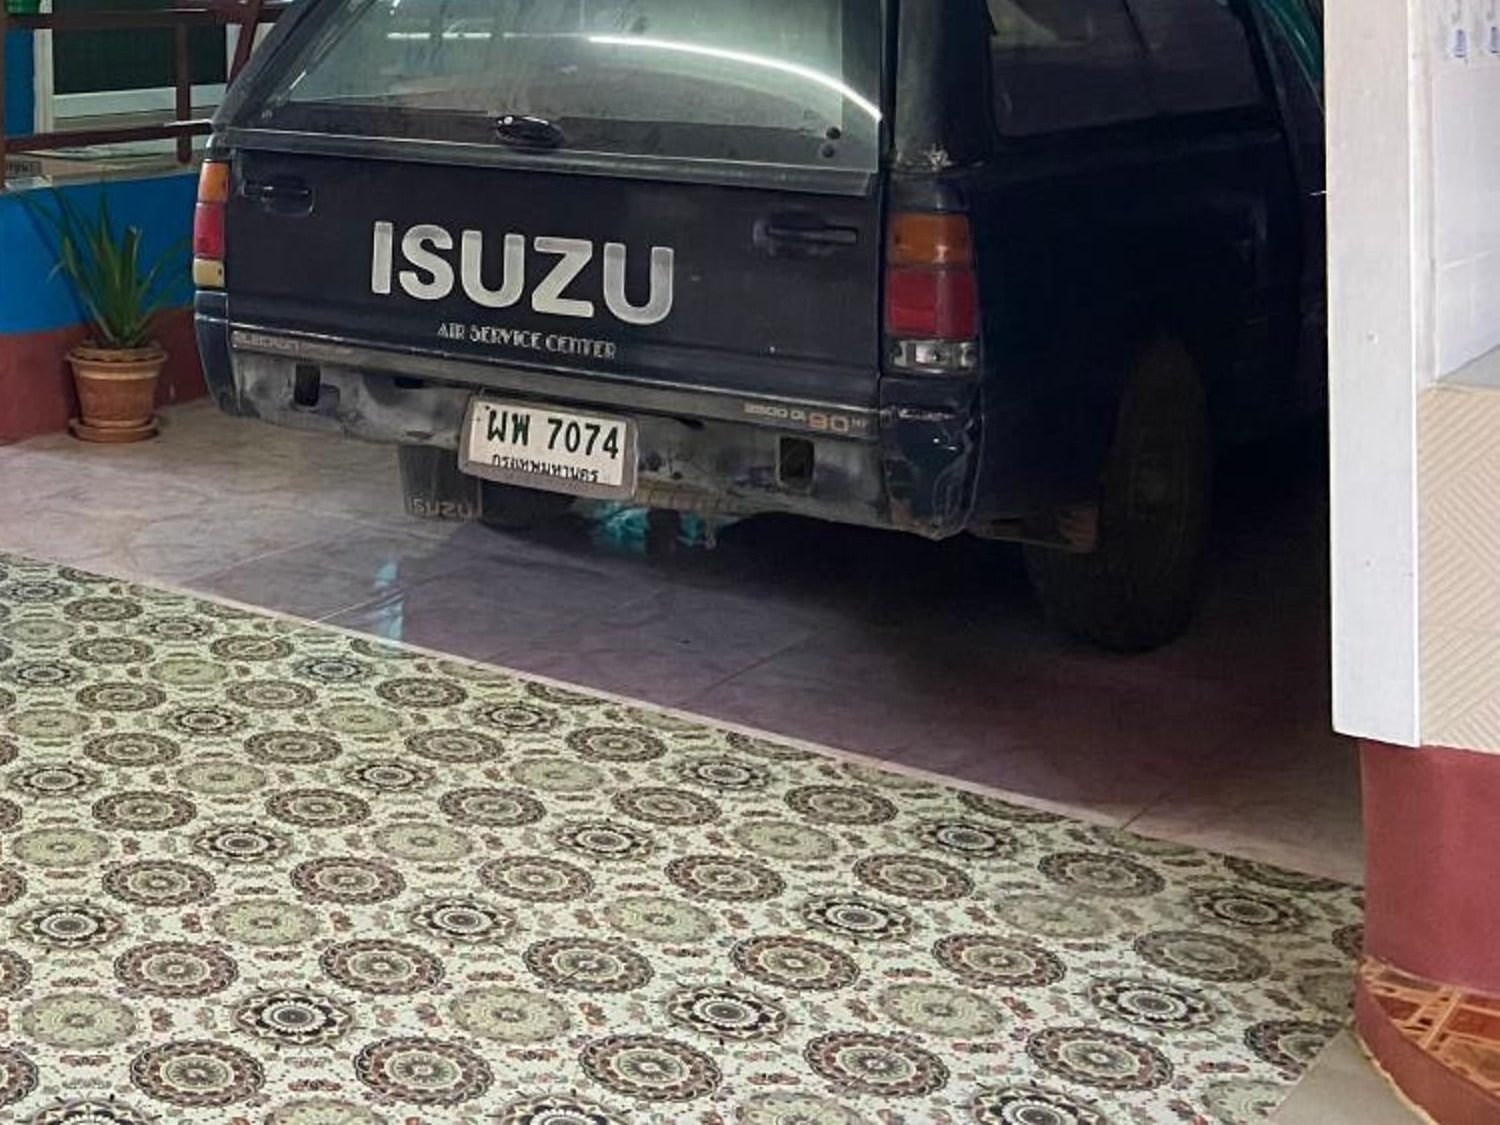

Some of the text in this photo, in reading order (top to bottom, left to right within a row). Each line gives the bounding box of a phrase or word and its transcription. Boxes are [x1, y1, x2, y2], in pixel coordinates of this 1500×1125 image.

[371, 221, 675, 325] ISUZU
[437, 323, 617, 360] AIR SERVICE CENTER
[548, 418, 619, 459] 7074
[492, 454, 599, 483] กรงเทพมหานคร
